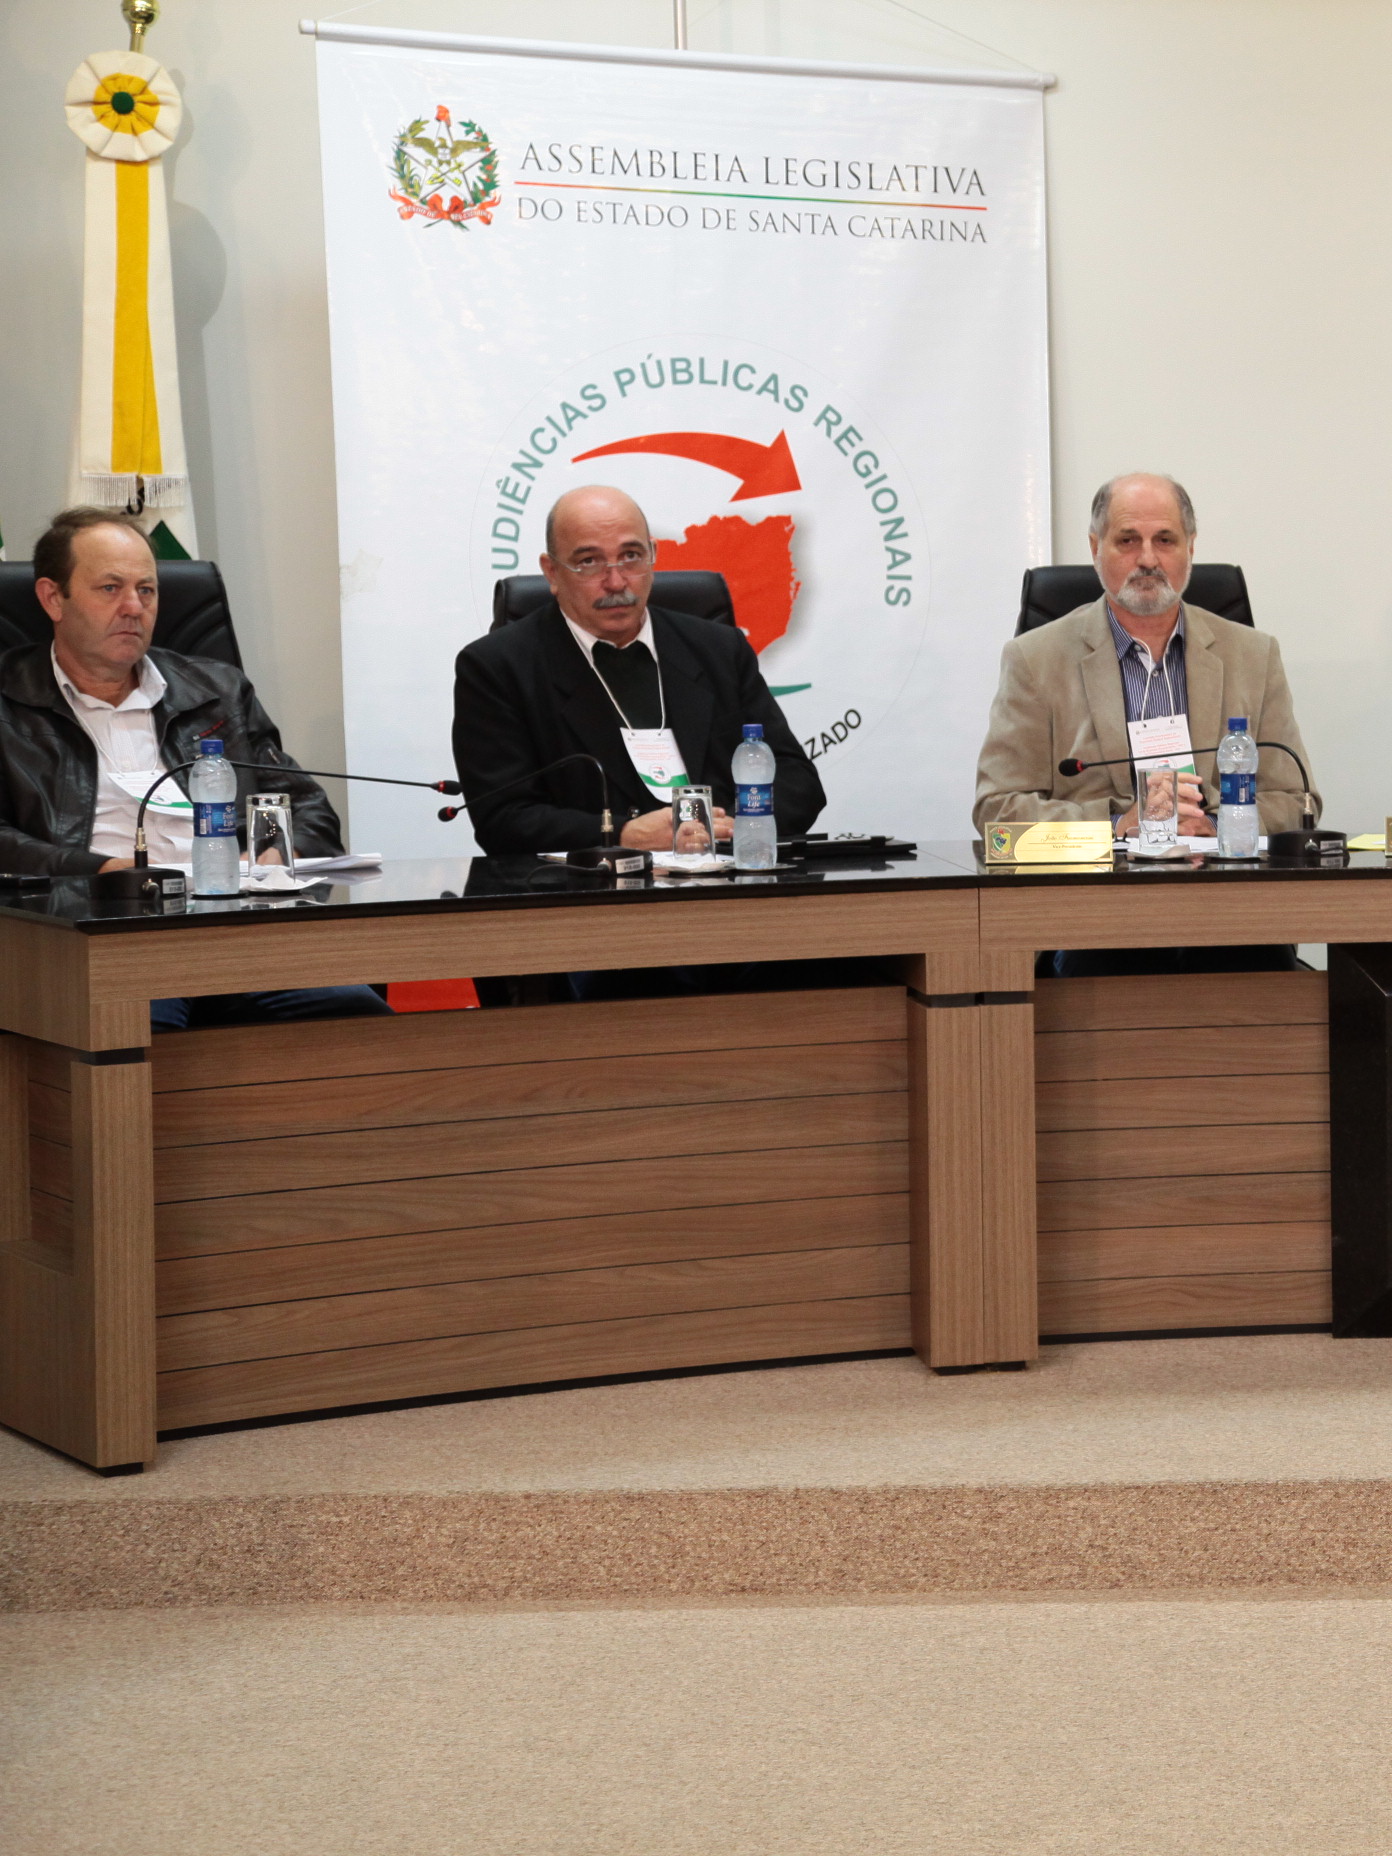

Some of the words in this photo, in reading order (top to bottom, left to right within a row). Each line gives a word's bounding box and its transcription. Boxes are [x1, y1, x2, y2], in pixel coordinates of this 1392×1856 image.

[520, 142, 749, 185] ASSEMBLEIA
[763, 156, 987, 197] LEGISLATIVA
[517, 197, 564, 222] DO
[576, 200, 689, 228] ESTADO
[701, 206, 737, 232] DE
[748, 210, 839, 237] SANTA
[847, 215, 988, 244] CATARINA
[491, 382, 608, 571] UDIÊNCIAS
[613, 353, 810, 413] PÚBLICAS
[812, 404, 913, 608] REGIONAIS
[804, 708, 862, 761] ZADO
